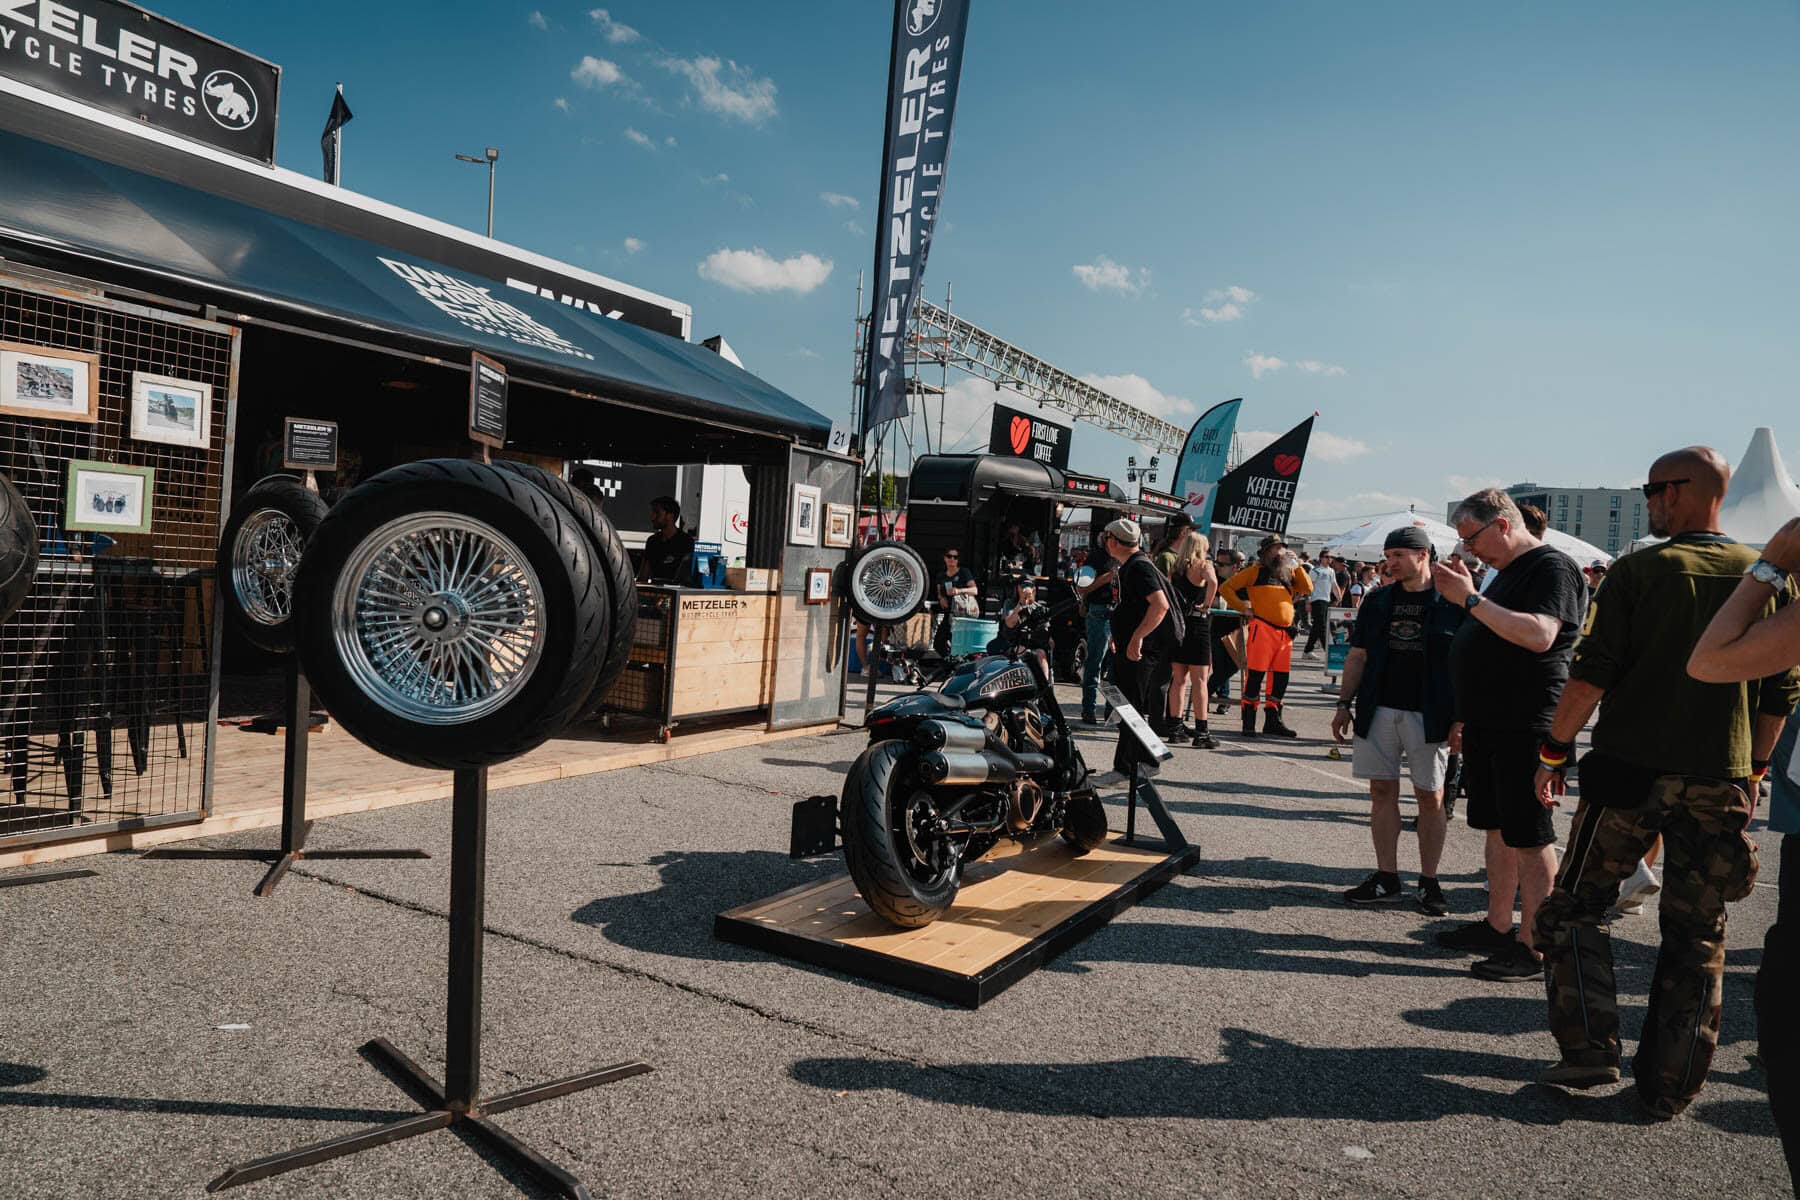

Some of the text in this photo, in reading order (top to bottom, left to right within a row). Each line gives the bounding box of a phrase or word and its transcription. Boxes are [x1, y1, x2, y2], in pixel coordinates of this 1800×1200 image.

[0, 25, 196, 117] YCLE TYRES
[924, 35, 950, 144] TYRES
[833, 430, 846, 446] 21
[1034, 442, 1053, 463] COFFEE
[1246, 476, 1296, 500] KAFFEE
[1247, 496, 1290, 512] UND FRISCHE
[1228, 505, 1285, 532] WAFFELN
[682, 600, 738, 610] METZELER
